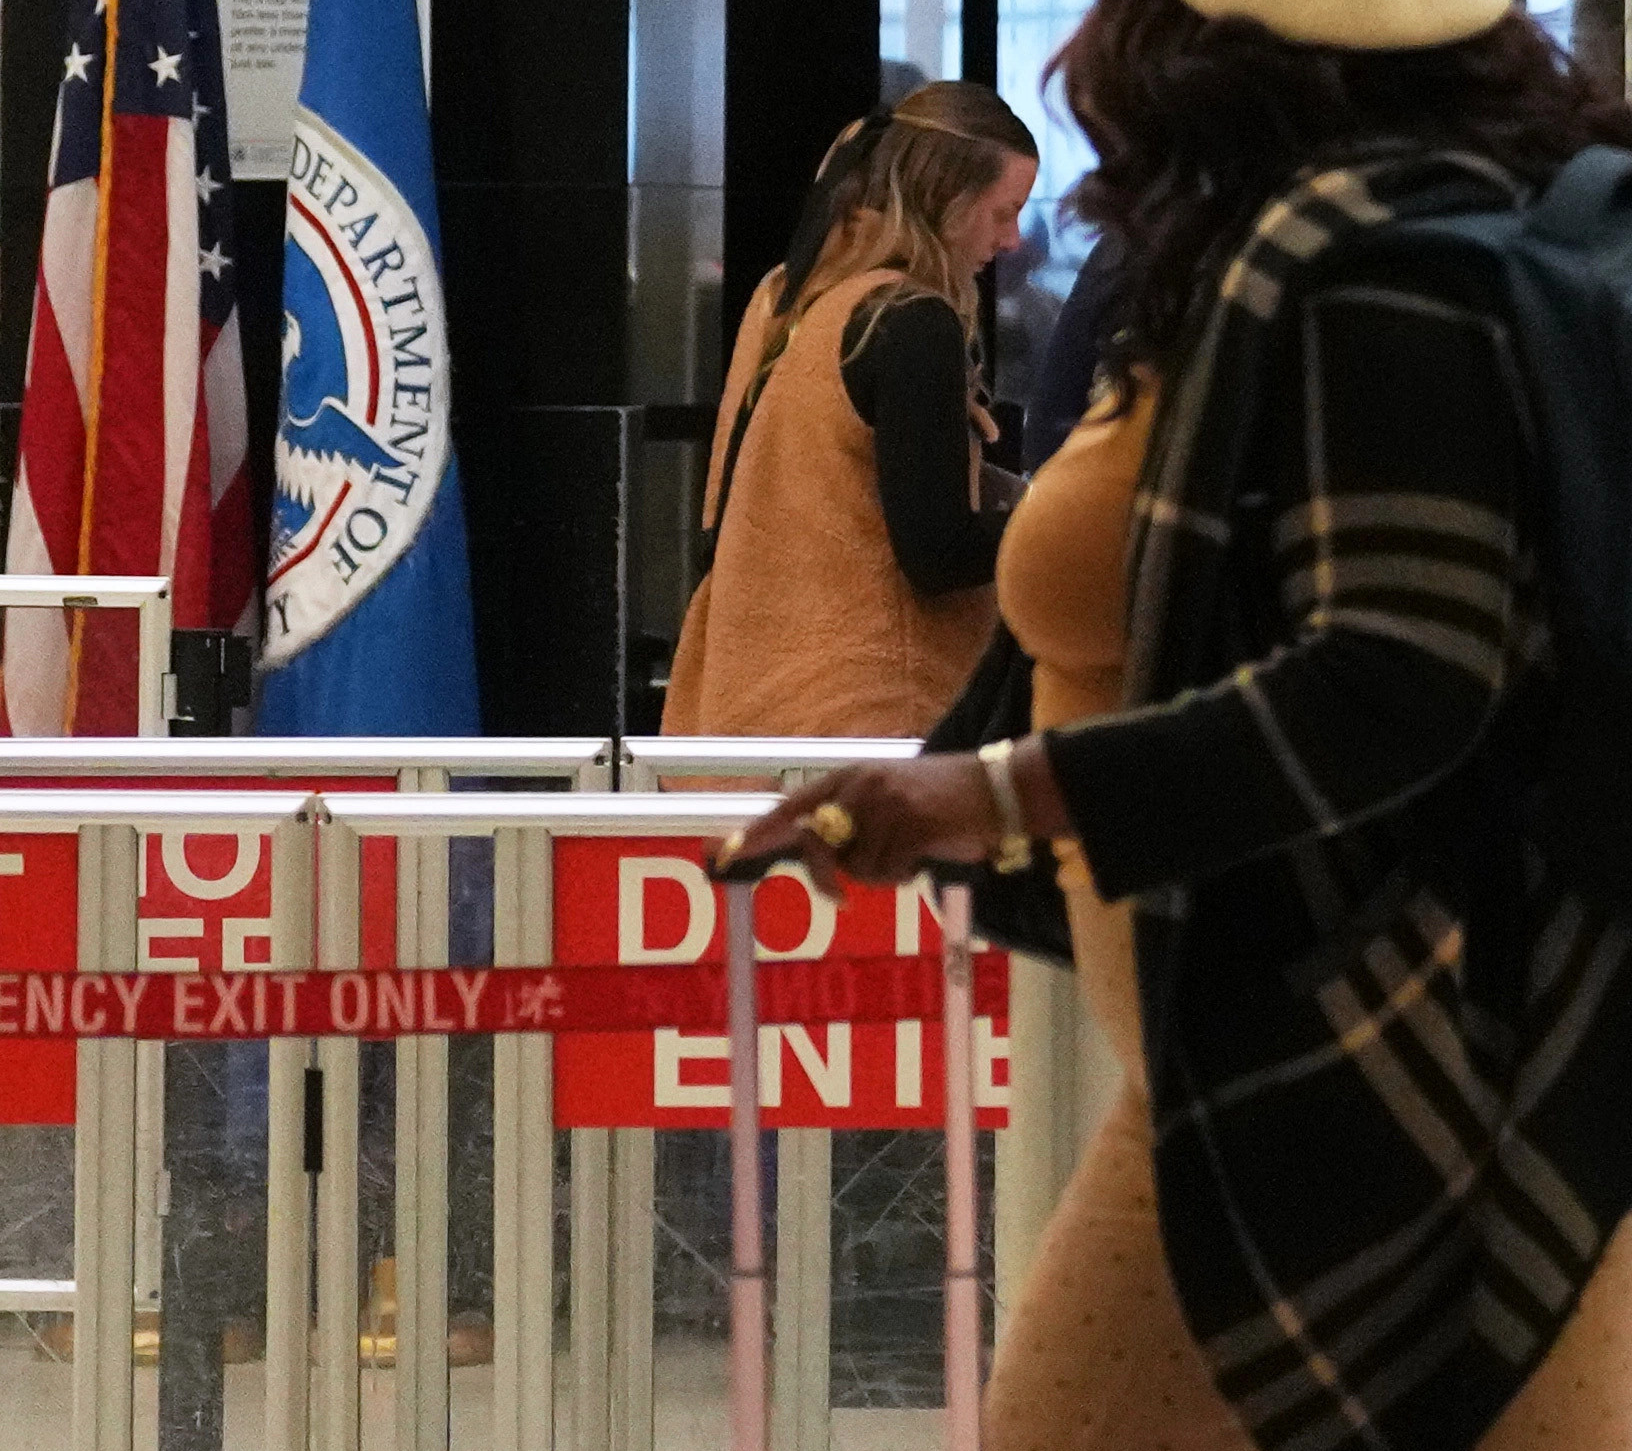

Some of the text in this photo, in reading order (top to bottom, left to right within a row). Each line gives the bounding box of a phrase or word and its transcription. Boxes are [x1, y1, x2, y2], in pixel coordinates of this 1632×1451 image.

[289, 134, 434, 586] DEPARTMENT OF
[173, 972, 306, 1033] EXIT
[331, 971, 489, 1033] ONLY
